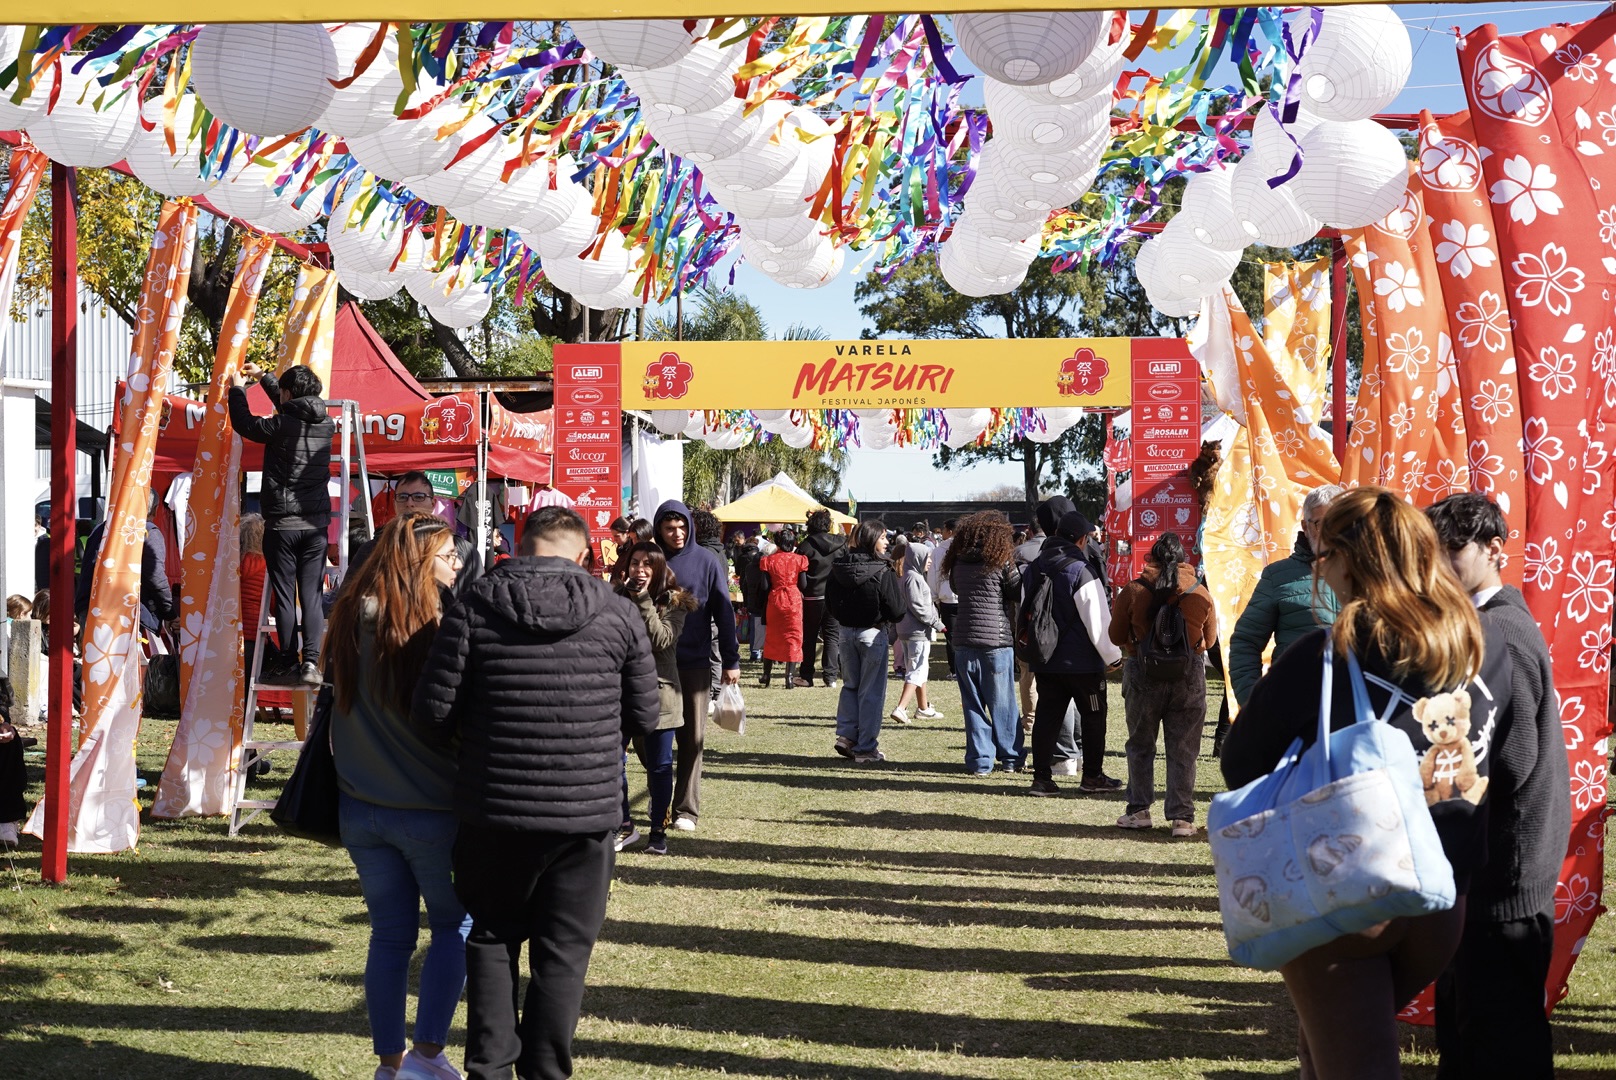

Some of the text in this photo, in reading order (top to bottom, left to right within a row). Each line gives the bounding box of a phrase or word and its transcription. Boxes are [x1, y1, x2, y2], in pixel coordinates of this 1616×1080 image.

[835, 345, 912, 356] VARELA
[792, 357, 955, 400] MATSURI
[821, 397, 926, 406] FESTIVAL JAPONÉS
[577, 432, 610, 440] ROSALEN
[1154, 428, 1189, 436] ROSALEN
[568, 467, 608, 475] MICRODACER
[1146, 463, 1187, 471] MICRODACER
[458, 478, 472, 488] 90
[1151, 497, 1192, 505] EMBAJADOR
